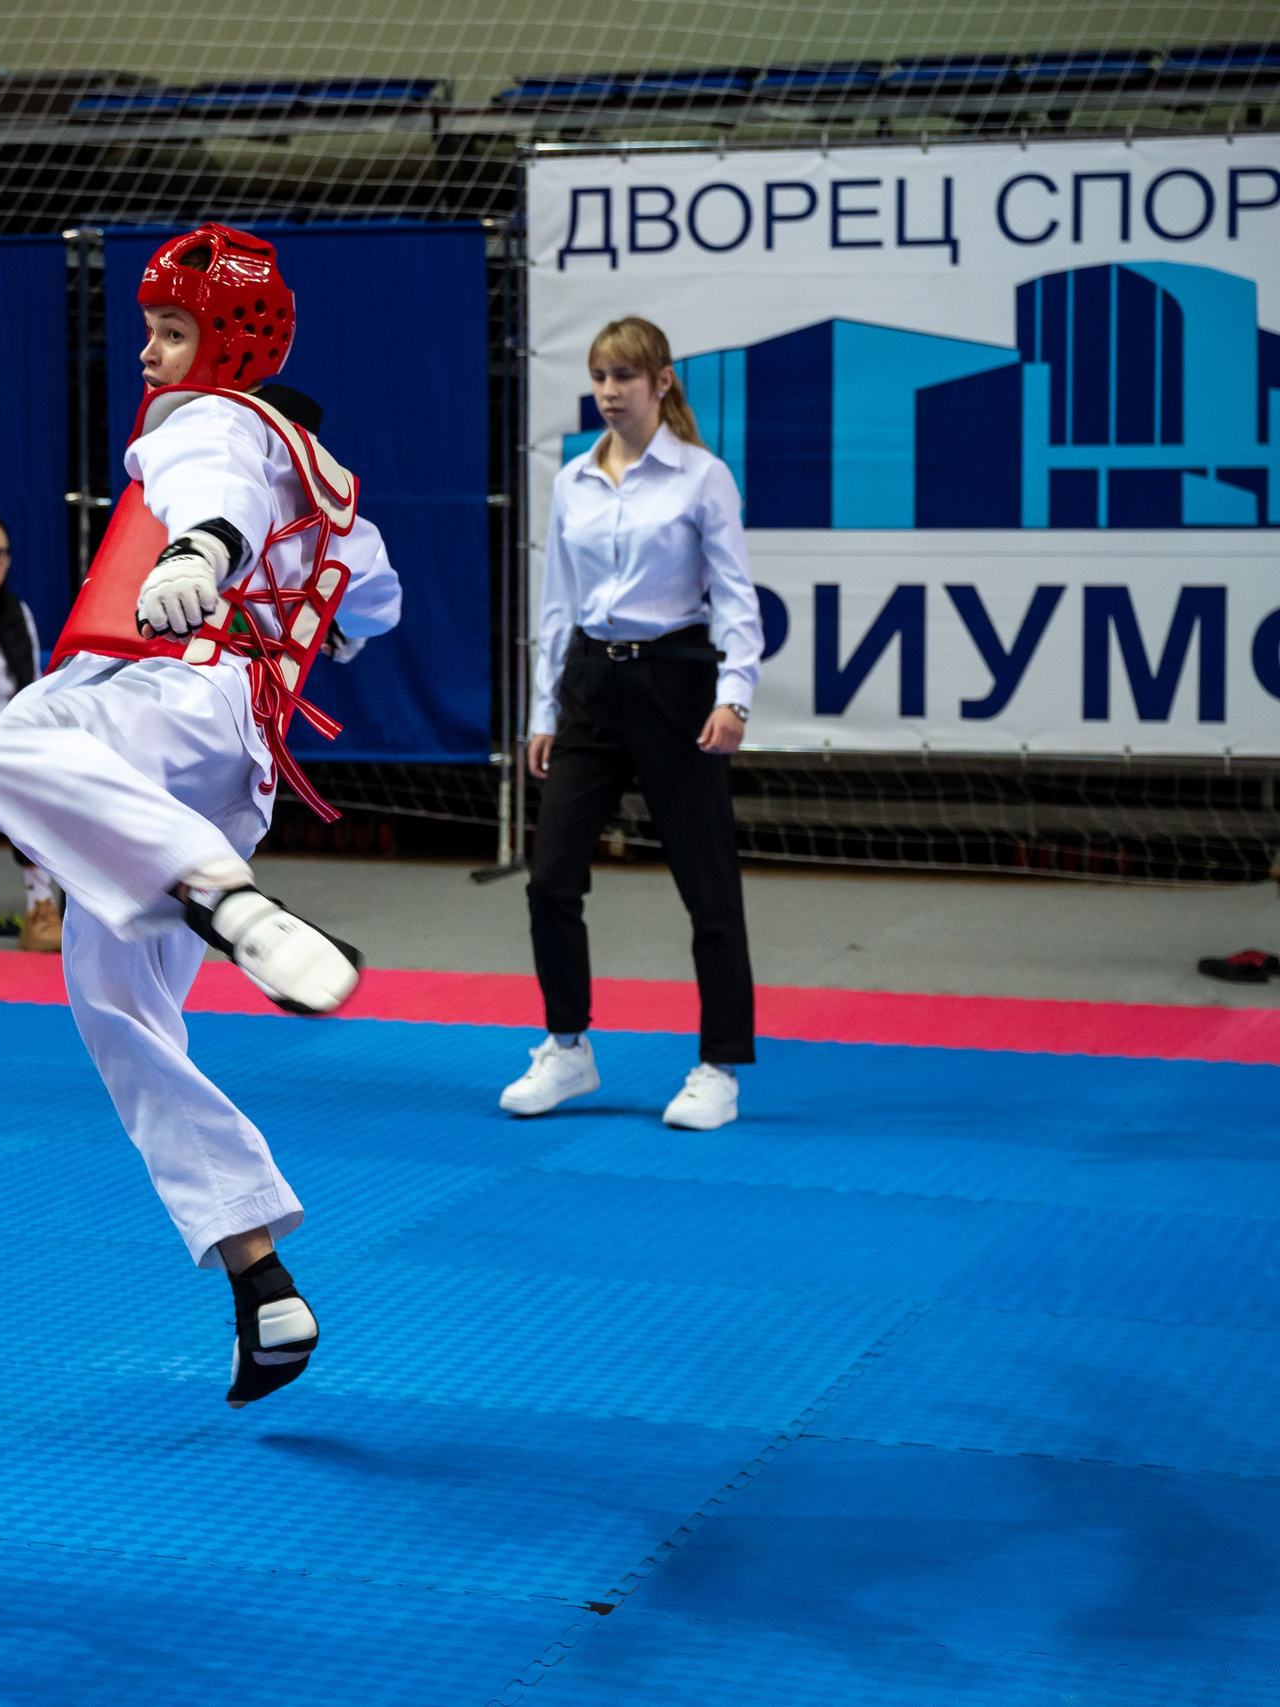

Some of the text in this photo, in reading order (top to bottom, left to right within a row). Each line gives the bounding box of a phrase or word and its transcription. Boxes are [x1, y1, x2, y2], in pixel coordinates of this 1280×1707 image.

[557, 167, 1280, 271] ДВОРЕЦ СПОР
[754, 583, 1280, 724] ИУМ
